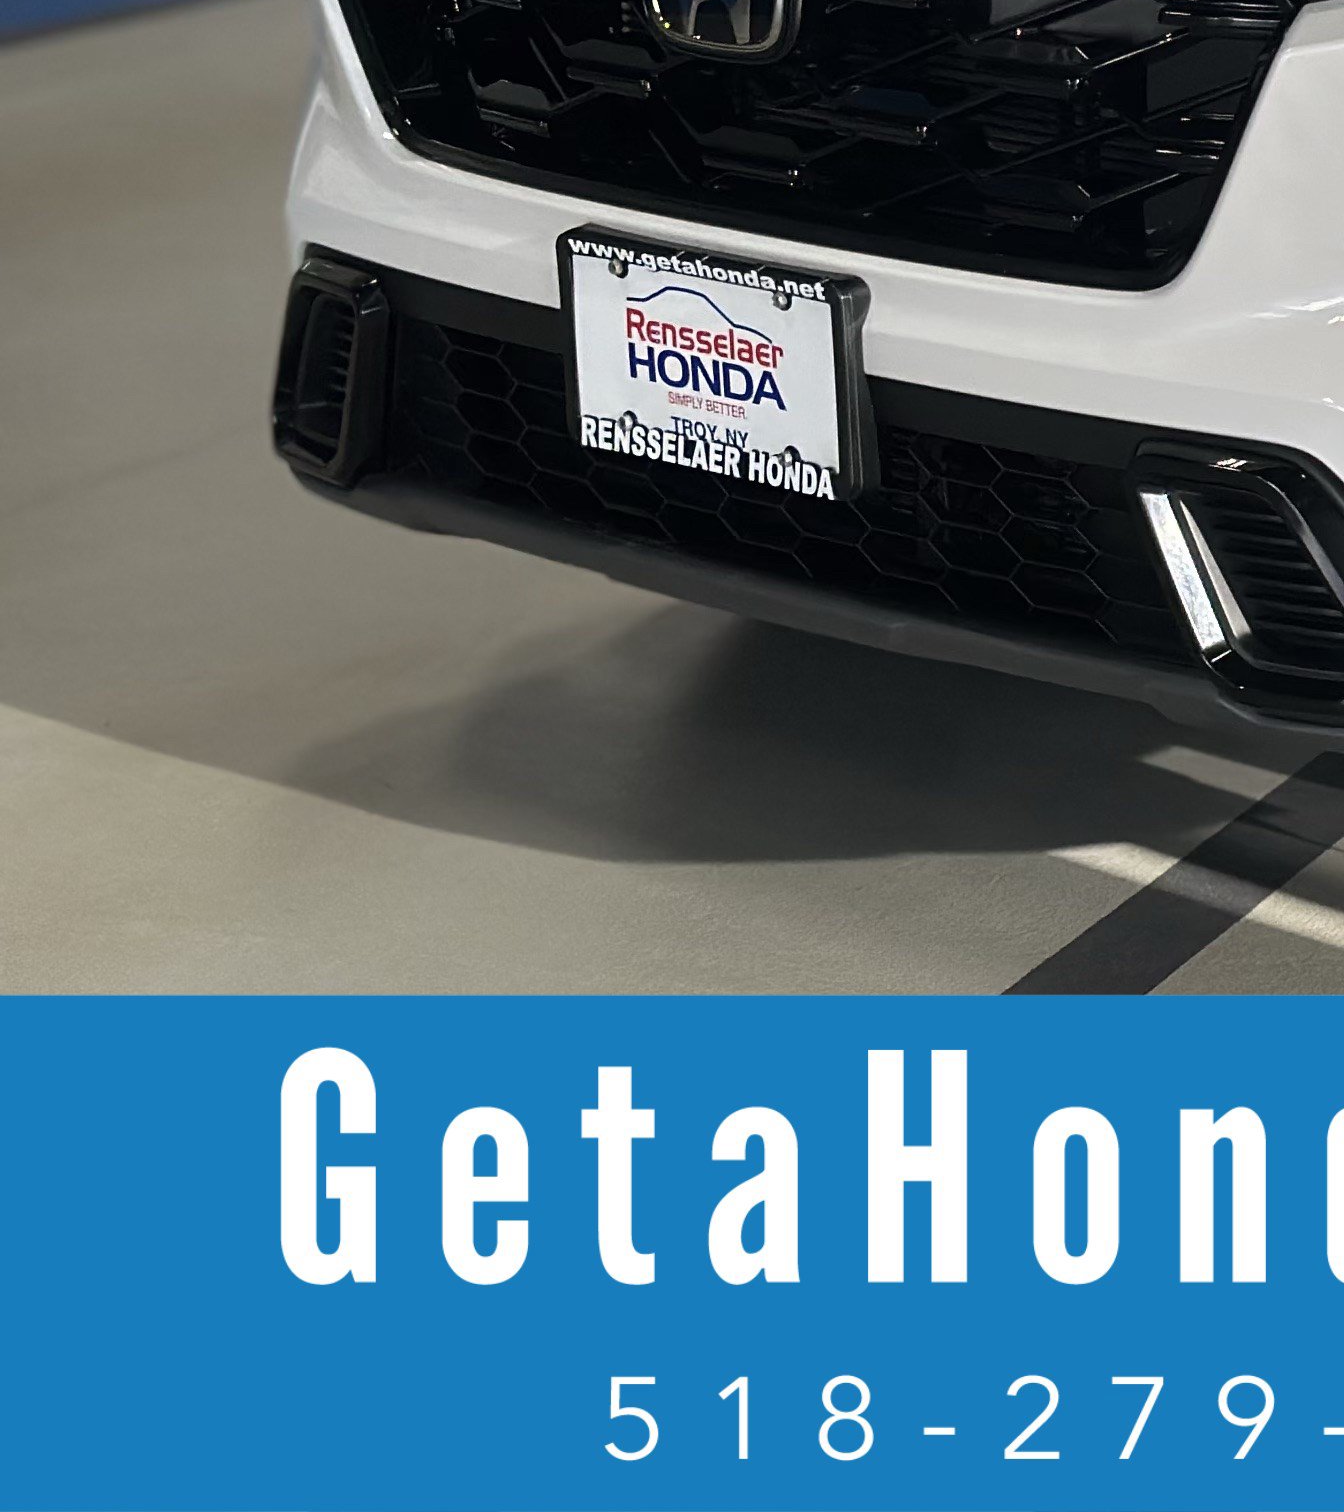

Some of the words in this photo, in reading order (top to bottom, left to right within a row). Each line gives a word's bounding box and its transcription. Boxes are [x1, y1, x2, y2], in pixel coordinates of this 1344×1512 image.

[568, 238, 826, 301] www.getahonda.net
[626, 307, 784, 369] Rensselaer
[628, 341, 787, 412] HONDA
[668, 391, 703, 410] SIMPLY
[705, 399, 747, 420] BETTER
[581, 417, 742, 478] RENSSELAER
[749, 450, 835, 500] HONDA
[725, 428, 749, 449] NY
